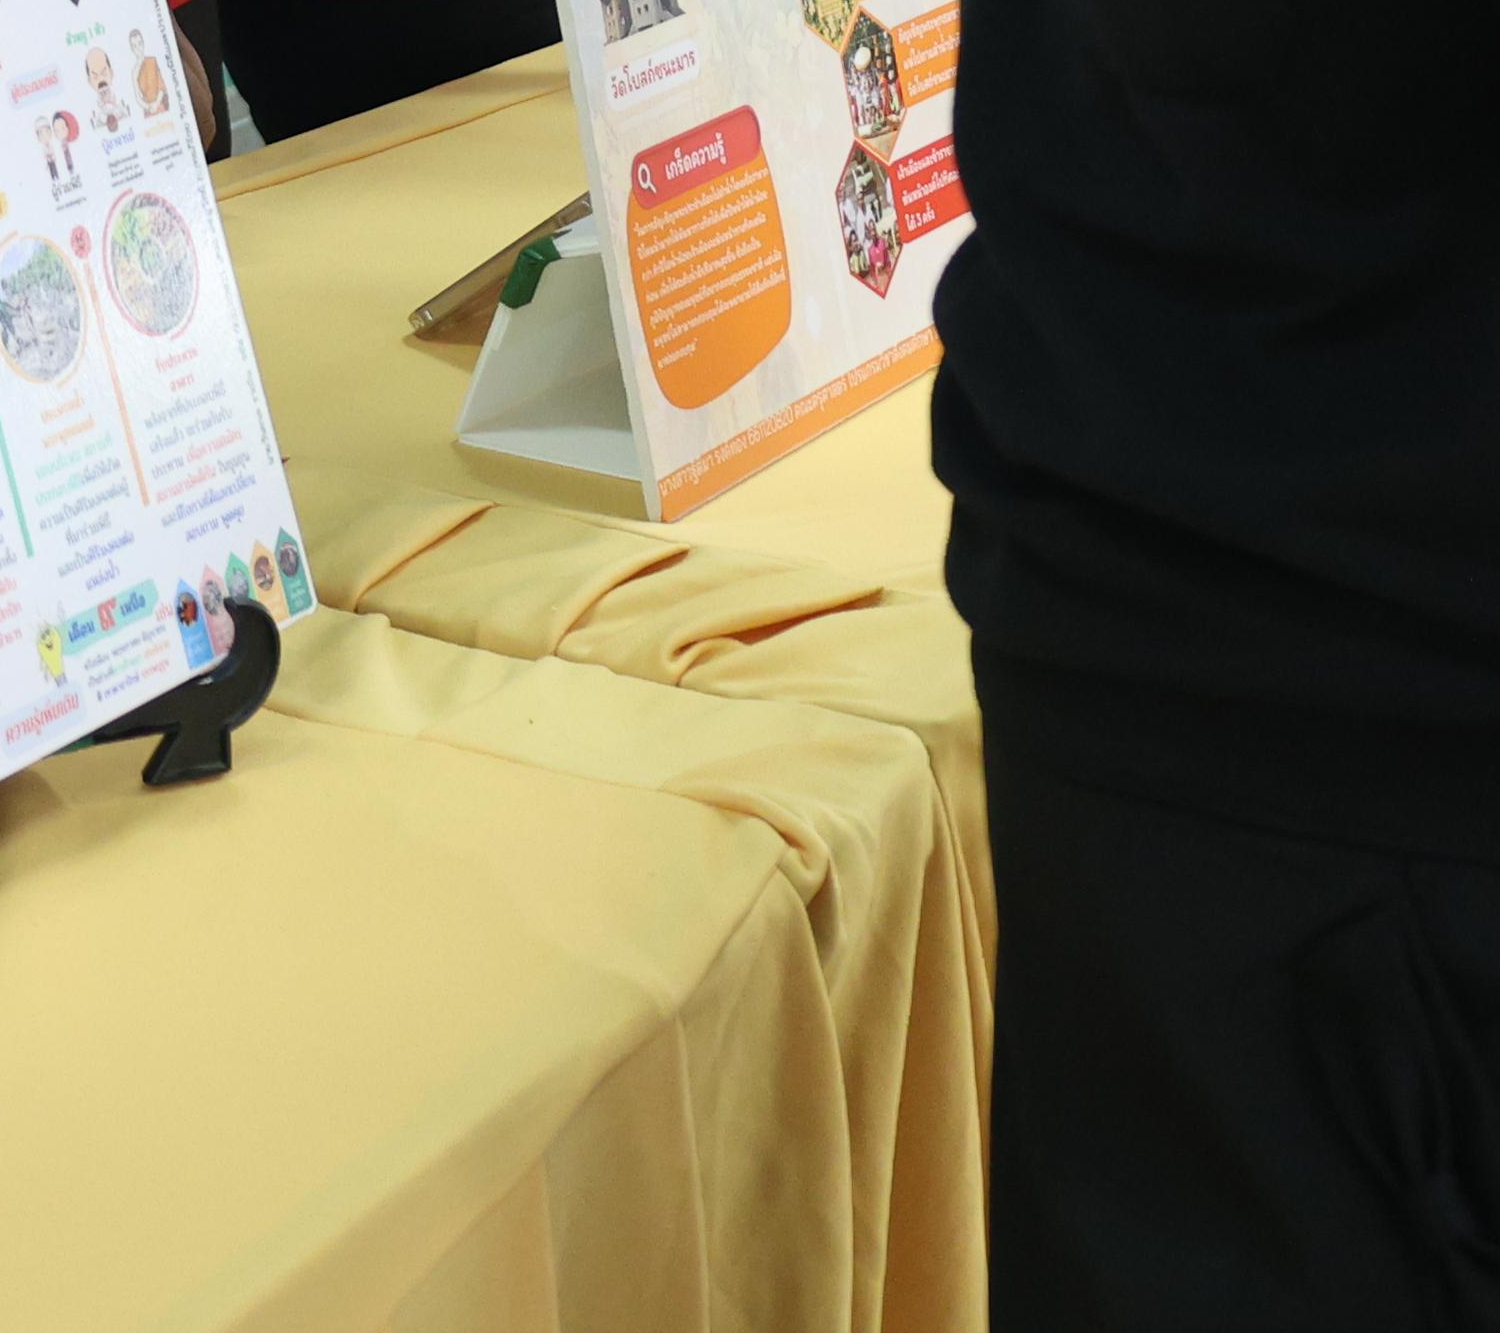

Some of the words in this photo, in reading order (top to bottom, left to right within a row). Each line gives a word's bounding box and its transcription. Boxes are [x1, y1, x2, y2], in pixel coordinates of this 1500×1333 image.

[664, 132, 727, 181] เกร็ดความรู้
